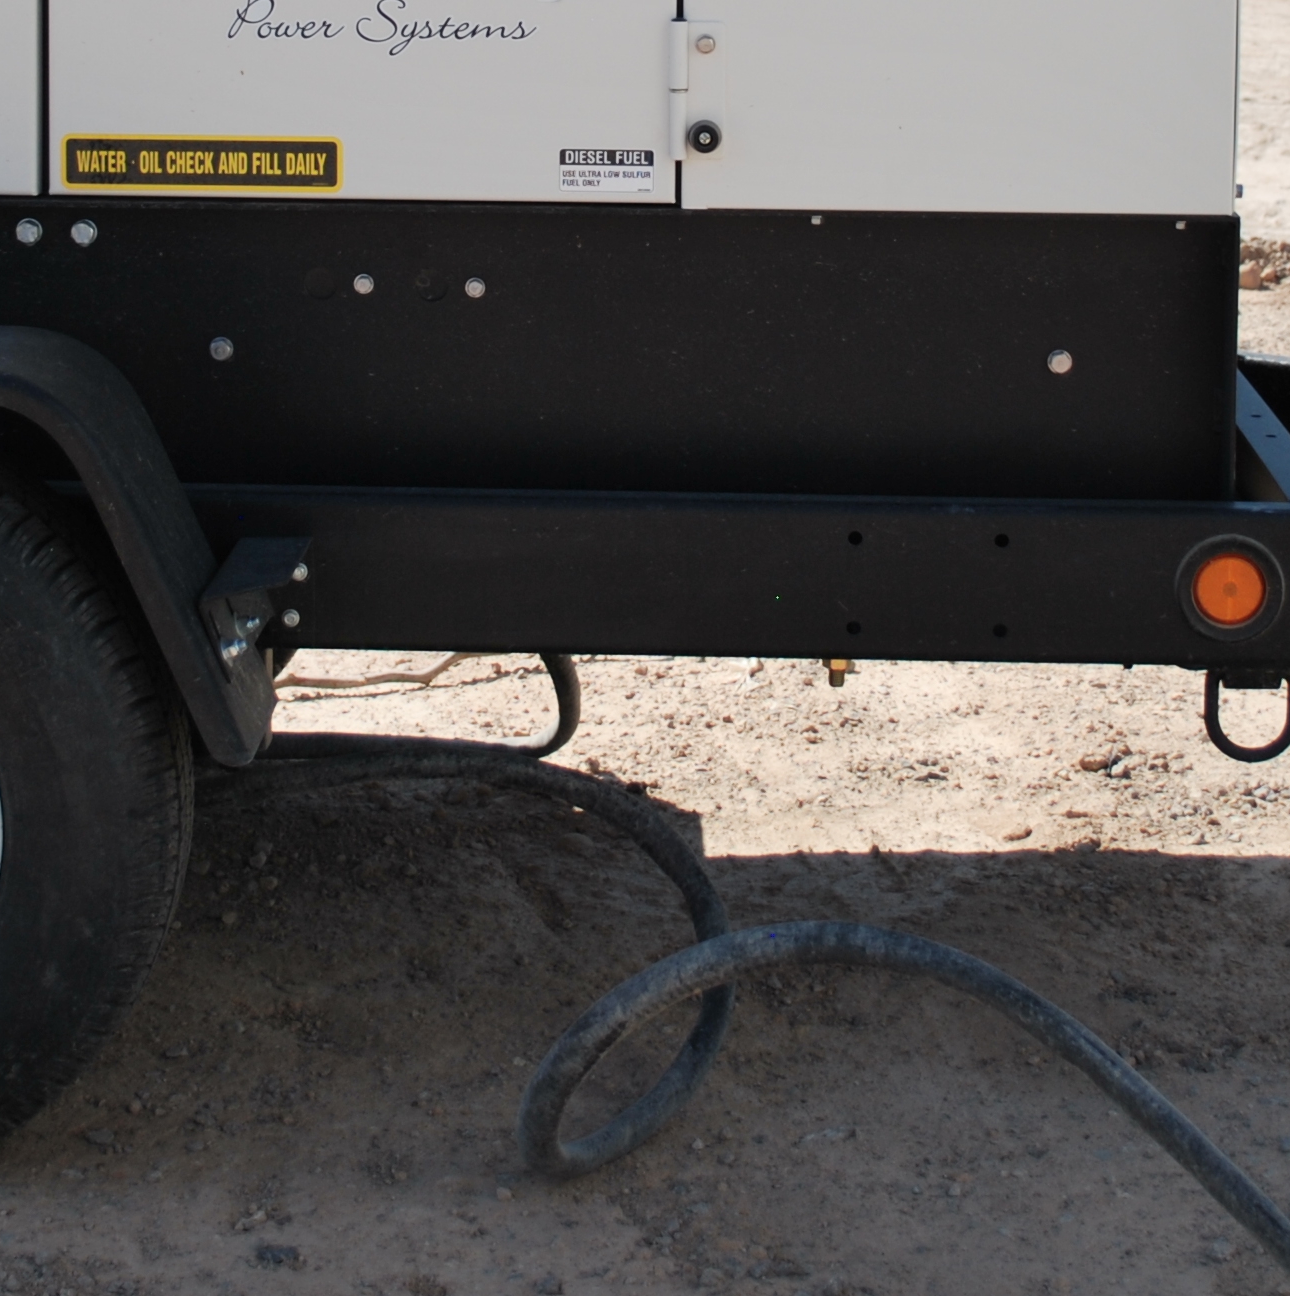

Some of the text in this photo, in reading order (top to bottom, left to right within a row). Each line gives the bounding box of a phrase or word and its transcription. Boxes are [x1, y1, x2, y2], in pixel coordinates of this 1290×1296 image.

[76, 150, 327, 176] WATER OIL CHECK AND FILL DAILY
[565, 150, 649, 165] DIESEL FUEL
[562, 170, 651, 179] USE ULTRA LOW SULFUR
